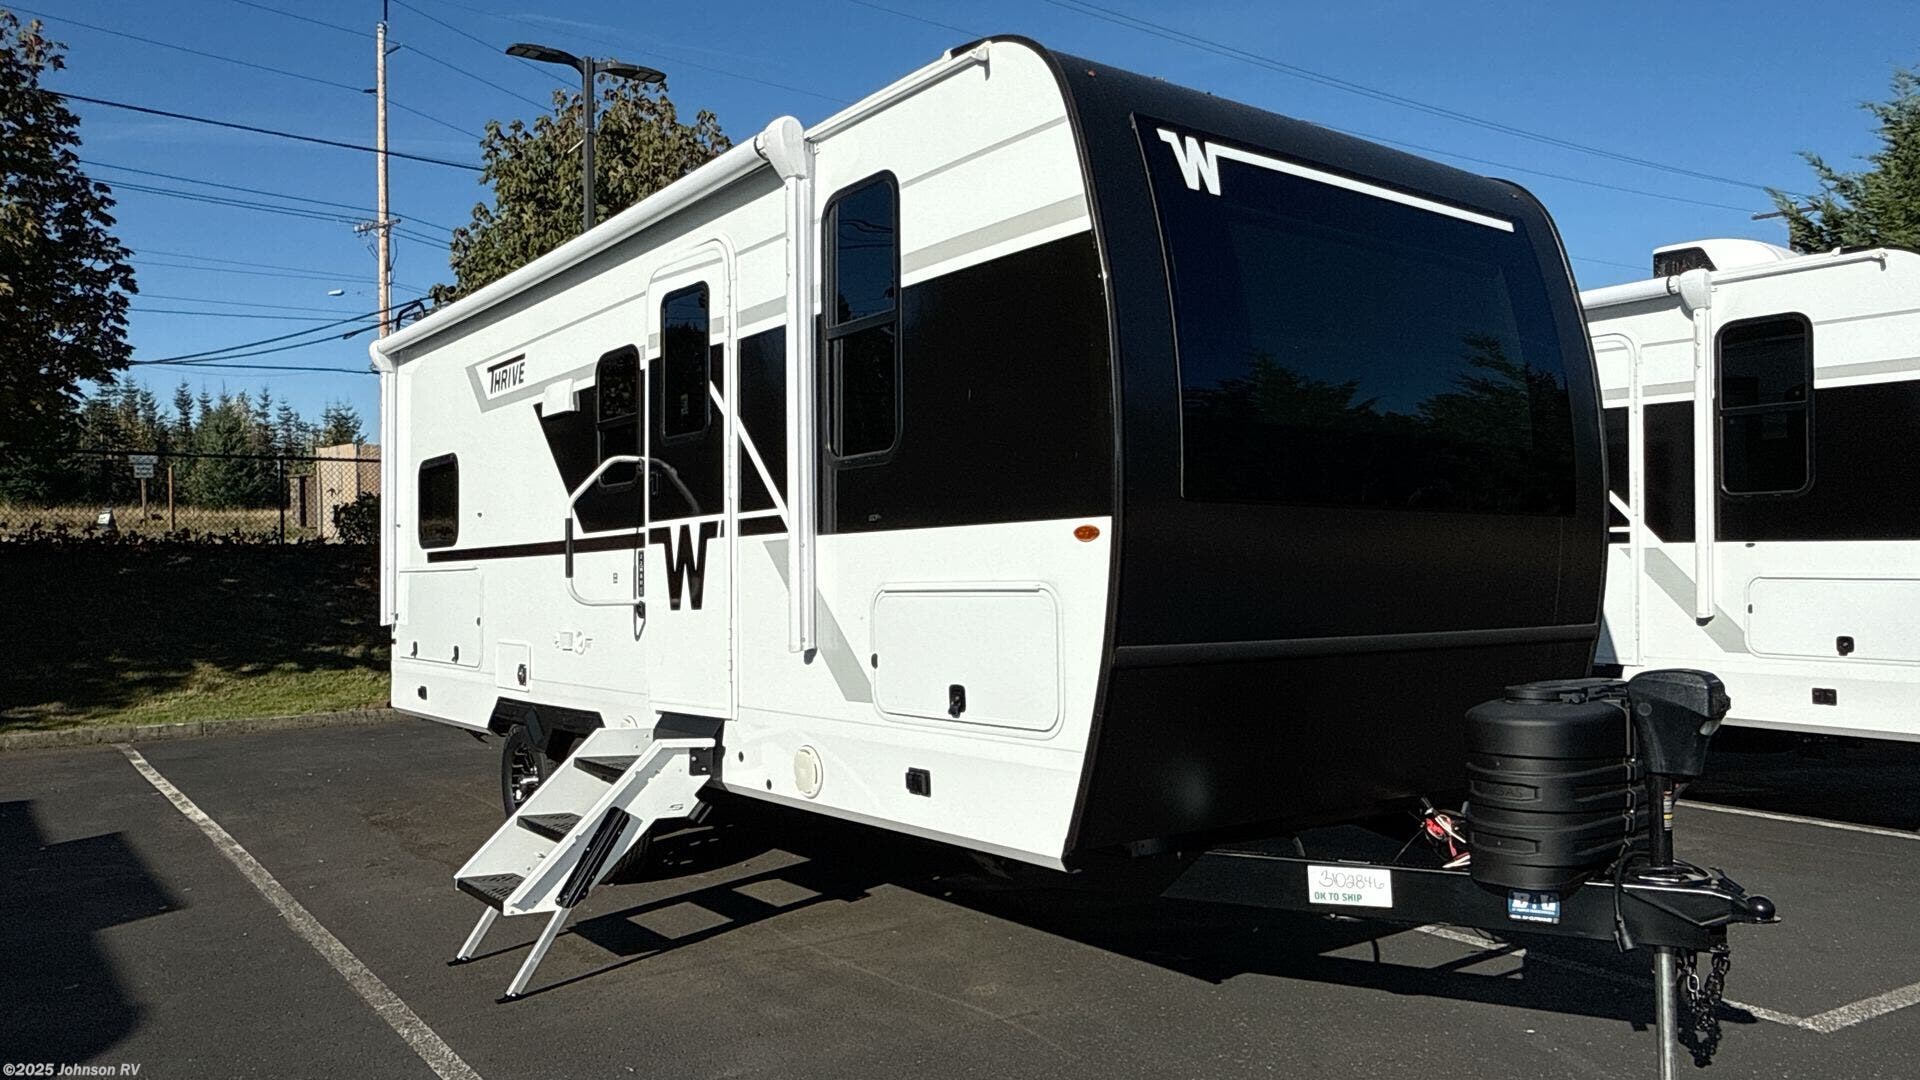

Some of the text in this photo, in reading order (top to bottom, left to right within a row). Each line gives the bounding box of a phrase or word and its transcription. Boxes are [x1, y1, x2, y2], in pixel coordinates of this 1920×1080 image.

[1156, 128, 1221, 196] W
[487, 352, 526, 394] THRIVE
[1314, 891, 1362, 902] OK TO SHIP
